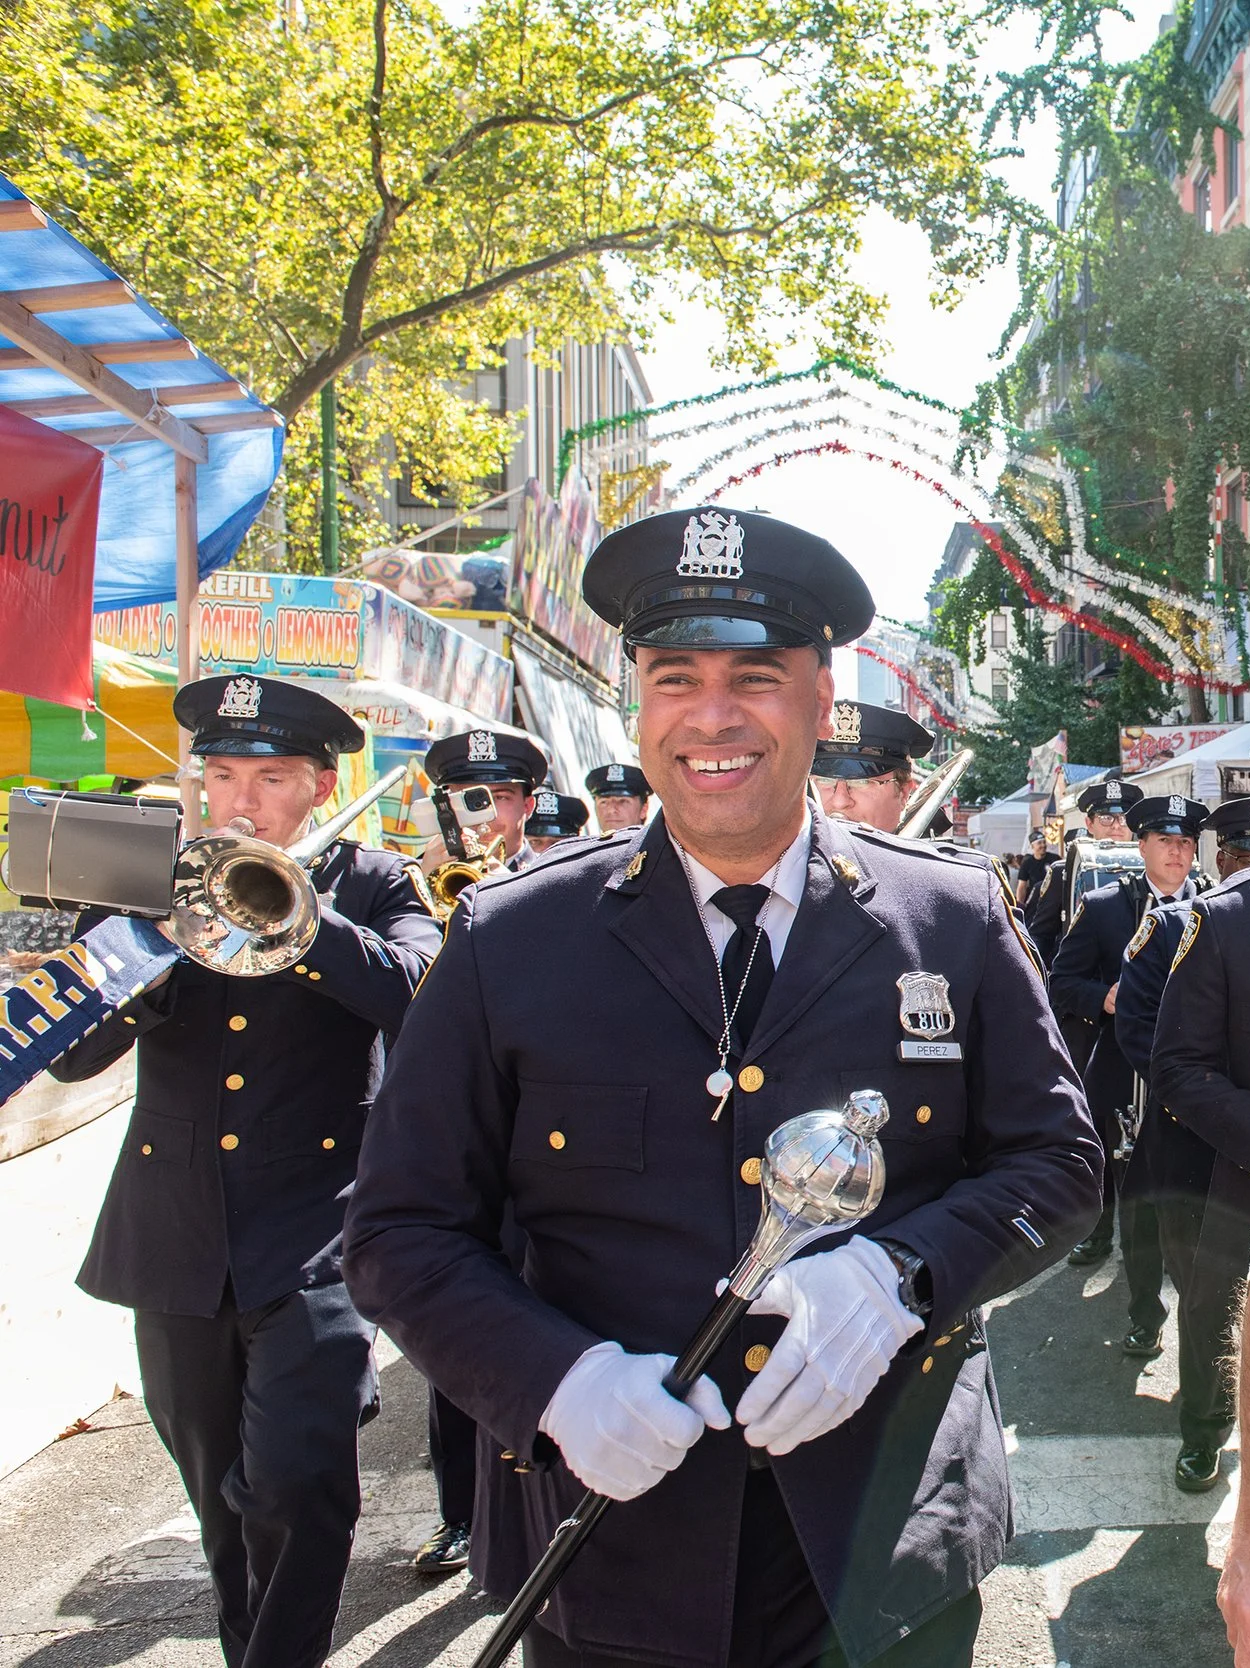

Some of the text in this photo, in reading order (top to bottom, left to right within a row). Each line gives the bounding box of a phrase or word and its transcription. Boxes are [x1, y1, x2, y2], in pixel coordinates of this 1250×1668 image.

[199, 603, 261, 662] OOTHIES
[276, 607, 362, 668] LEMONADES
[918, 1011, 945, 1030] 810
[917, 1046, 948, 1056] PEREZ
